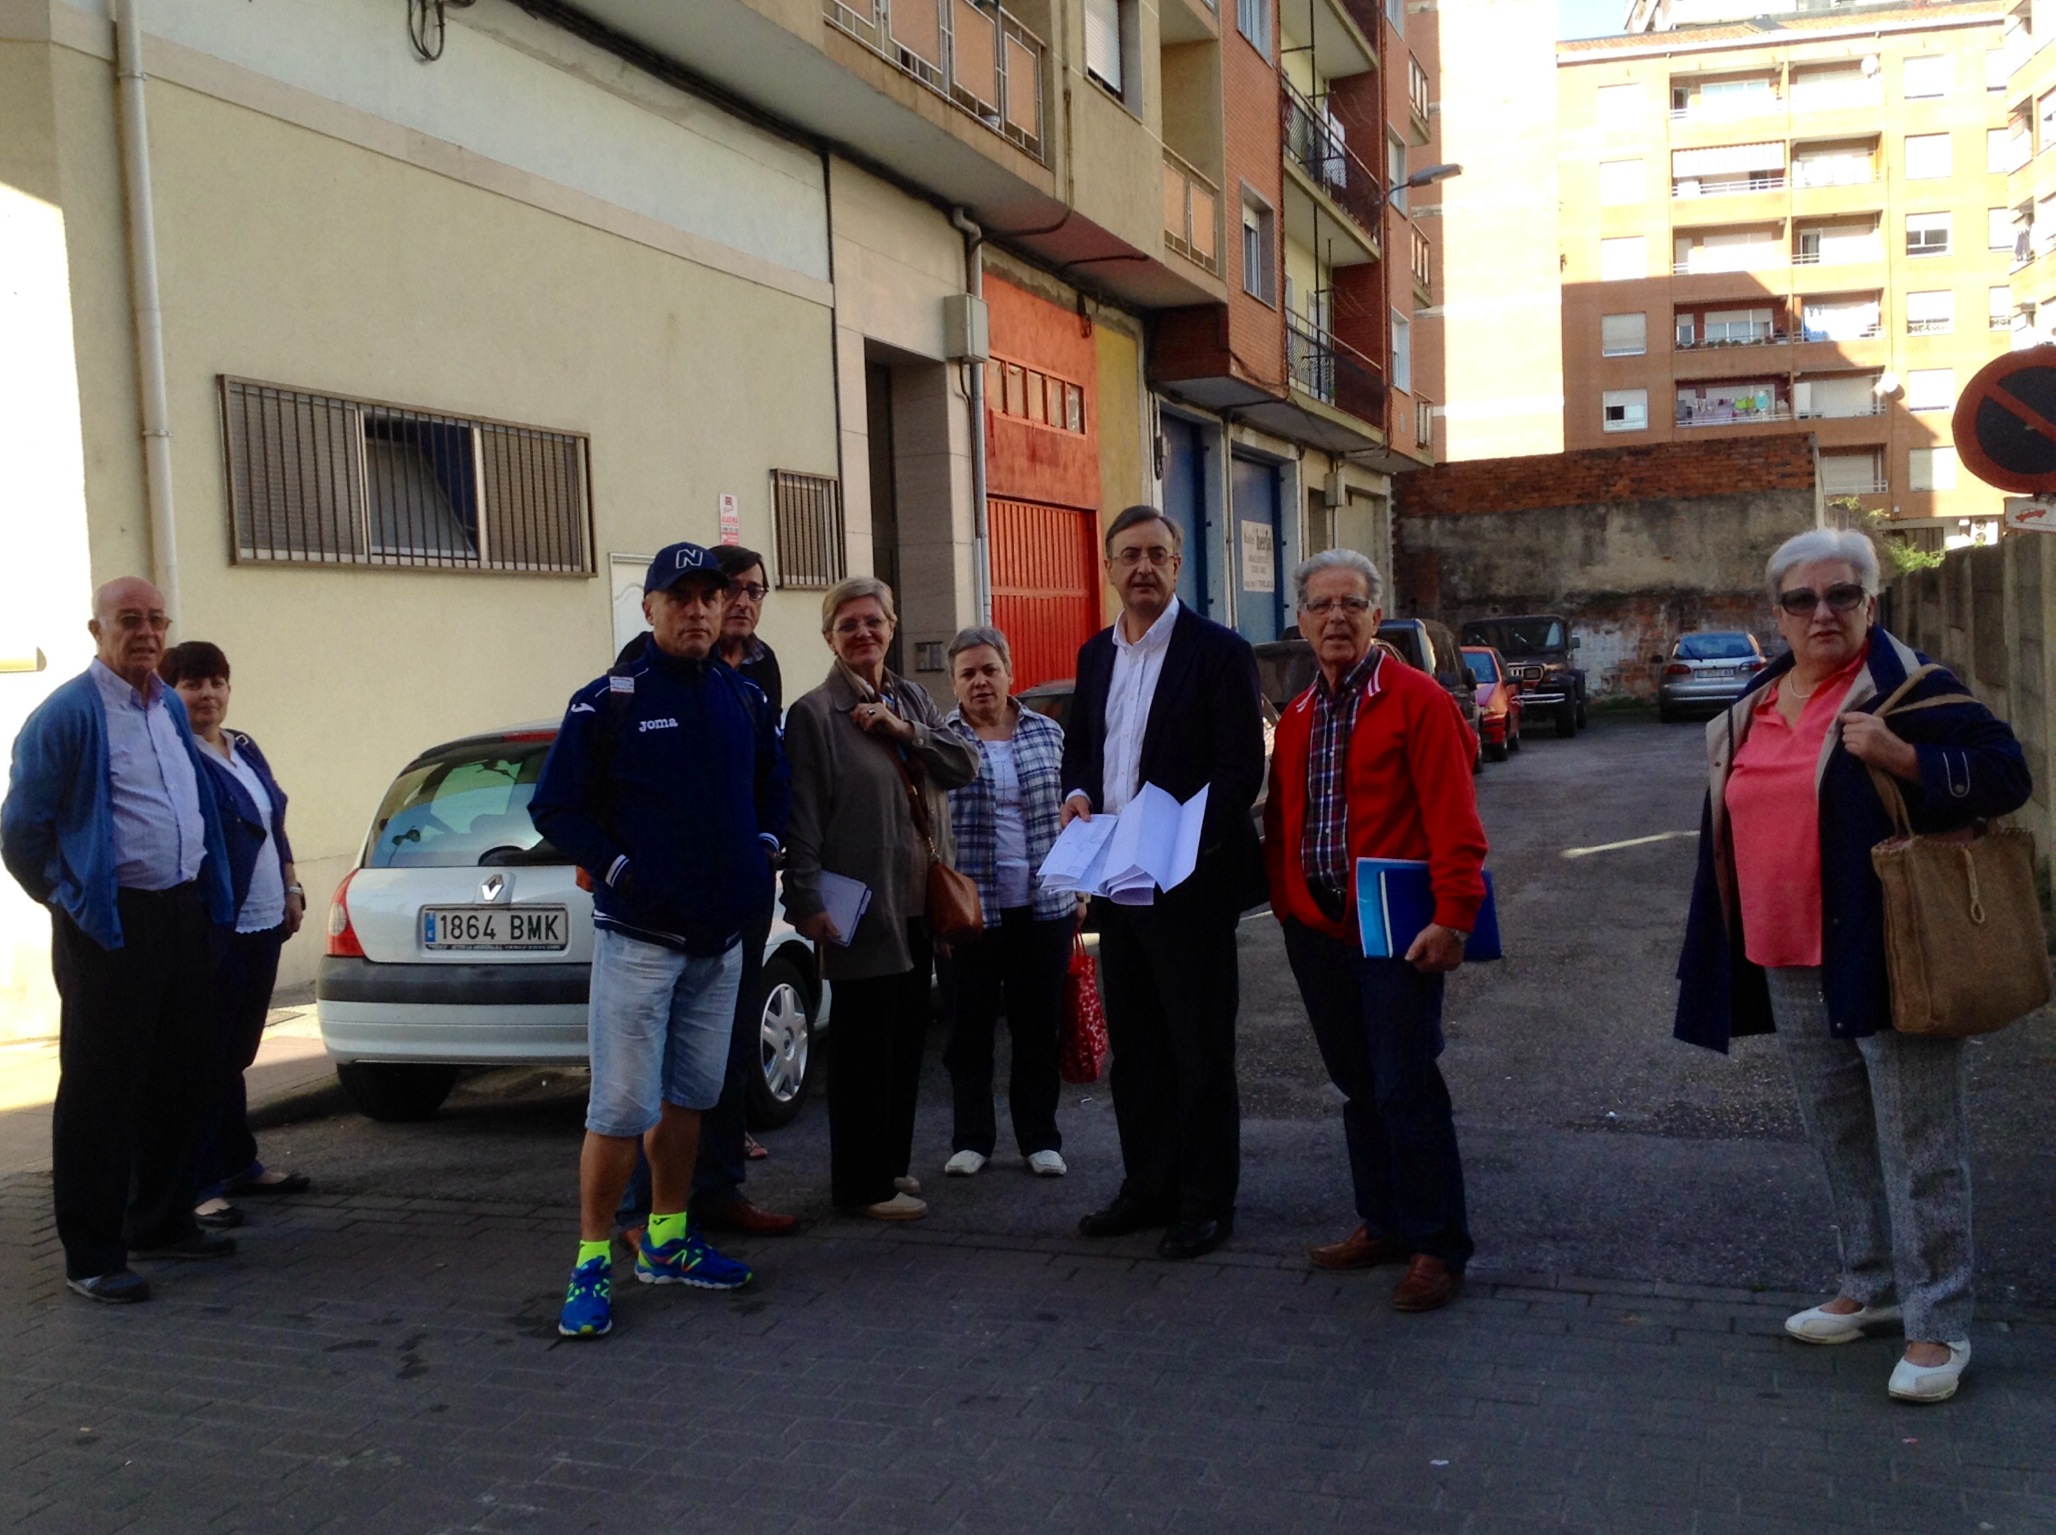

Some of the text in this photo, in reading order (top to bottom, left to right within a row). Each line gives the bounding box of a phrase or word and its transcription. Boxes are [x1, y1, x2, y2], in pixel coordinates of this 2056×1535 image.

[676, 549, 703, 568] N
[440, 914, 559, 940] 1864 BMK
